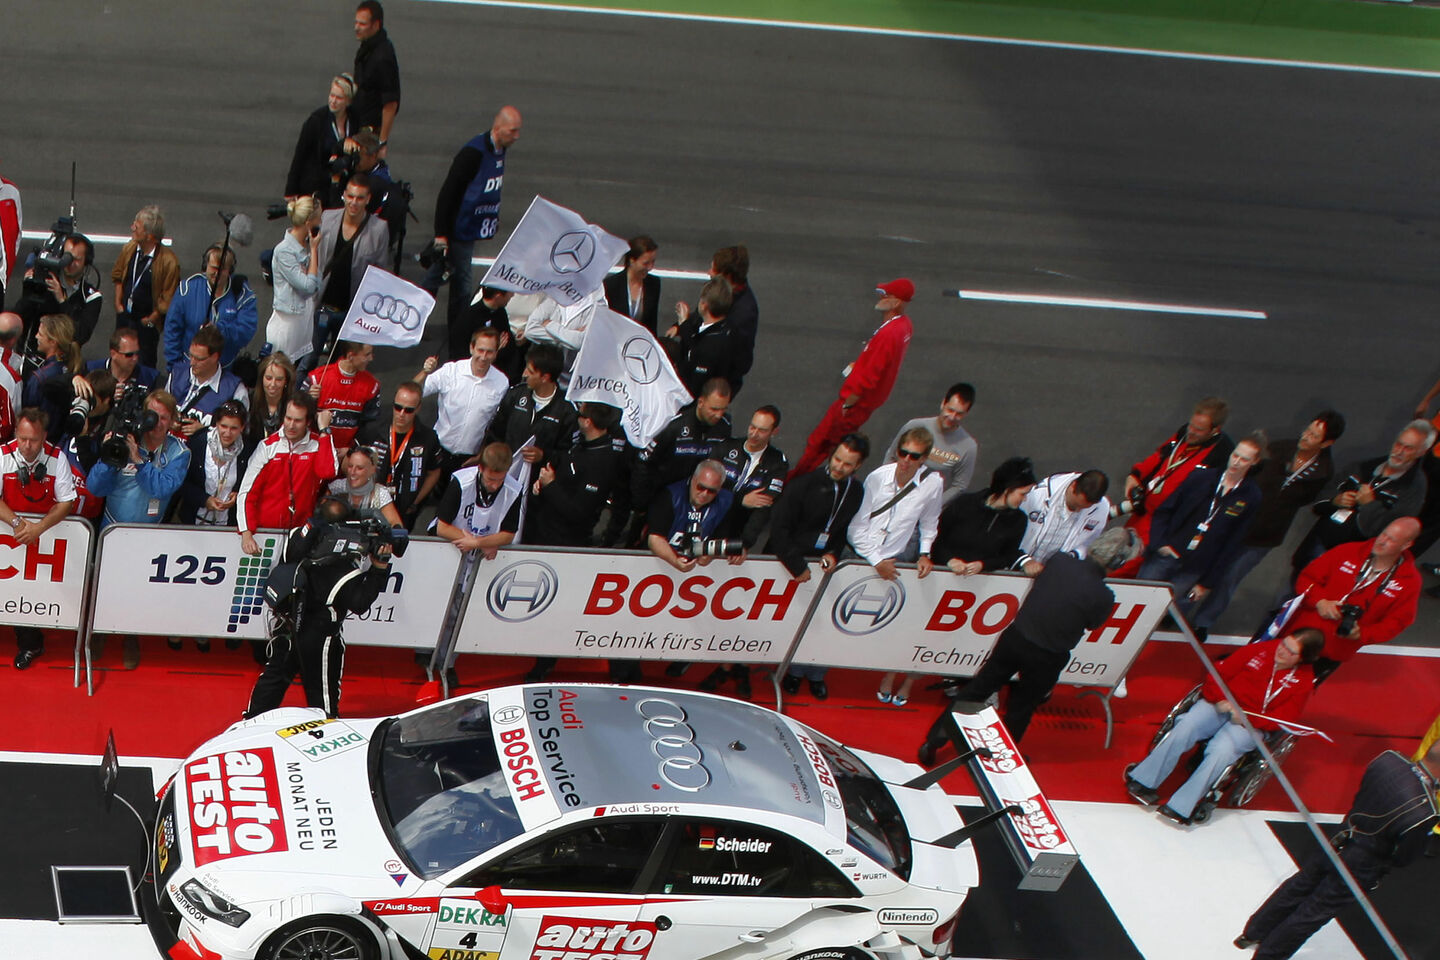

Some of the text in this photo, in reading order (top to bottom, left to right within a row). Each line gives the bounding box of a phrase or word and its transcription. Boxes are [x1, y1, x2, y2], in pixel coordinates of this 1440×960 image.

[354, 317, 381, 334] Audi
[148, 553, 227, 586] 125
[583, 573, 797, 621] BOSCH
[926, 588, 1147, 646] BOH
[574, 629, 772, 655] Technik fürs Leben
[558, 688, 584, 731] Audi
[285, 718, 330, 738] ADAC
[306, 729, 324, 741] 4
[304, 732, 364, 758] DEKRA
[532, 688, 582, 808] Top Service
[499, 728, 545, 802] BOSCH
[797, 733, 835, 788] BOSCH
[188, 757, 231, 856] TEST
[224, 750, 276, 852] auto
[286, 762, 315, 851] MONAT NEU
[609, 803, 681, 816] Audi Sport
[315, 796, 338, 850] JEDEN
[715, 836, 772, 854] Scheider
[692, 872, 762, 888] www.DTM.tv
[385, 902, 432, 914] Audi Sport
[438, 903, 508, 928] DEKRA
[882, 910, 936, 925] Nintendo
[459, 932, 478, 949] 4
[536, 922, 653, 952] auto
